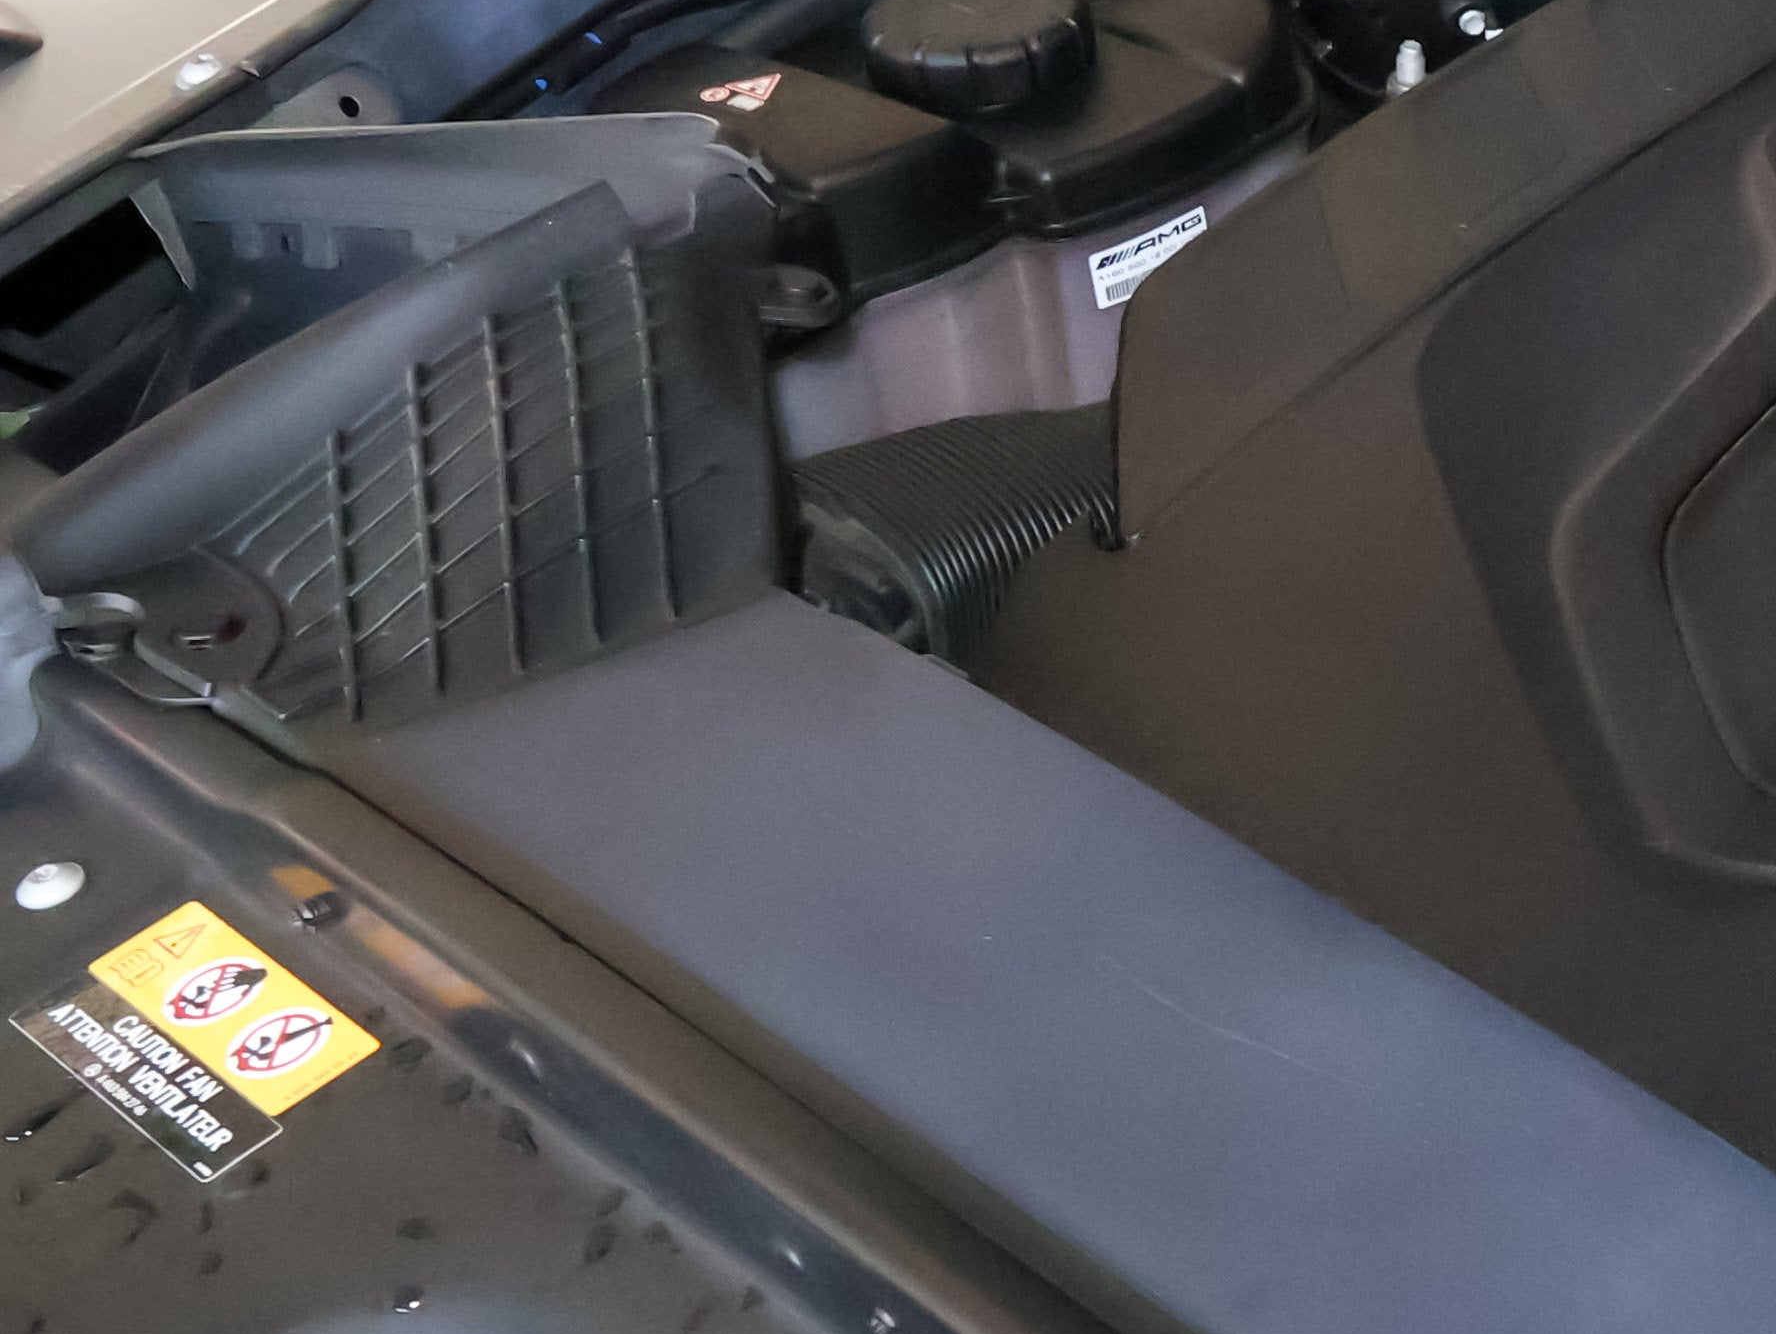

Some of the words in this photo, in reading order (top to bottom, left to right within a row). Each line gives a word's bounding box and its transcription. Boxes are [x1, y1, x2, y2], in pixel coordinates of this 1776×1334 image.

[1134, 214, 1202, 256] AMG
[45, 1001, 141, 1073] ATTENTION
[127, 1064, 234, 1152] VENTILATEUR
[107, 1012, 191, 1075] CAUTION
[174, 1065, 224, 1103] FAN
